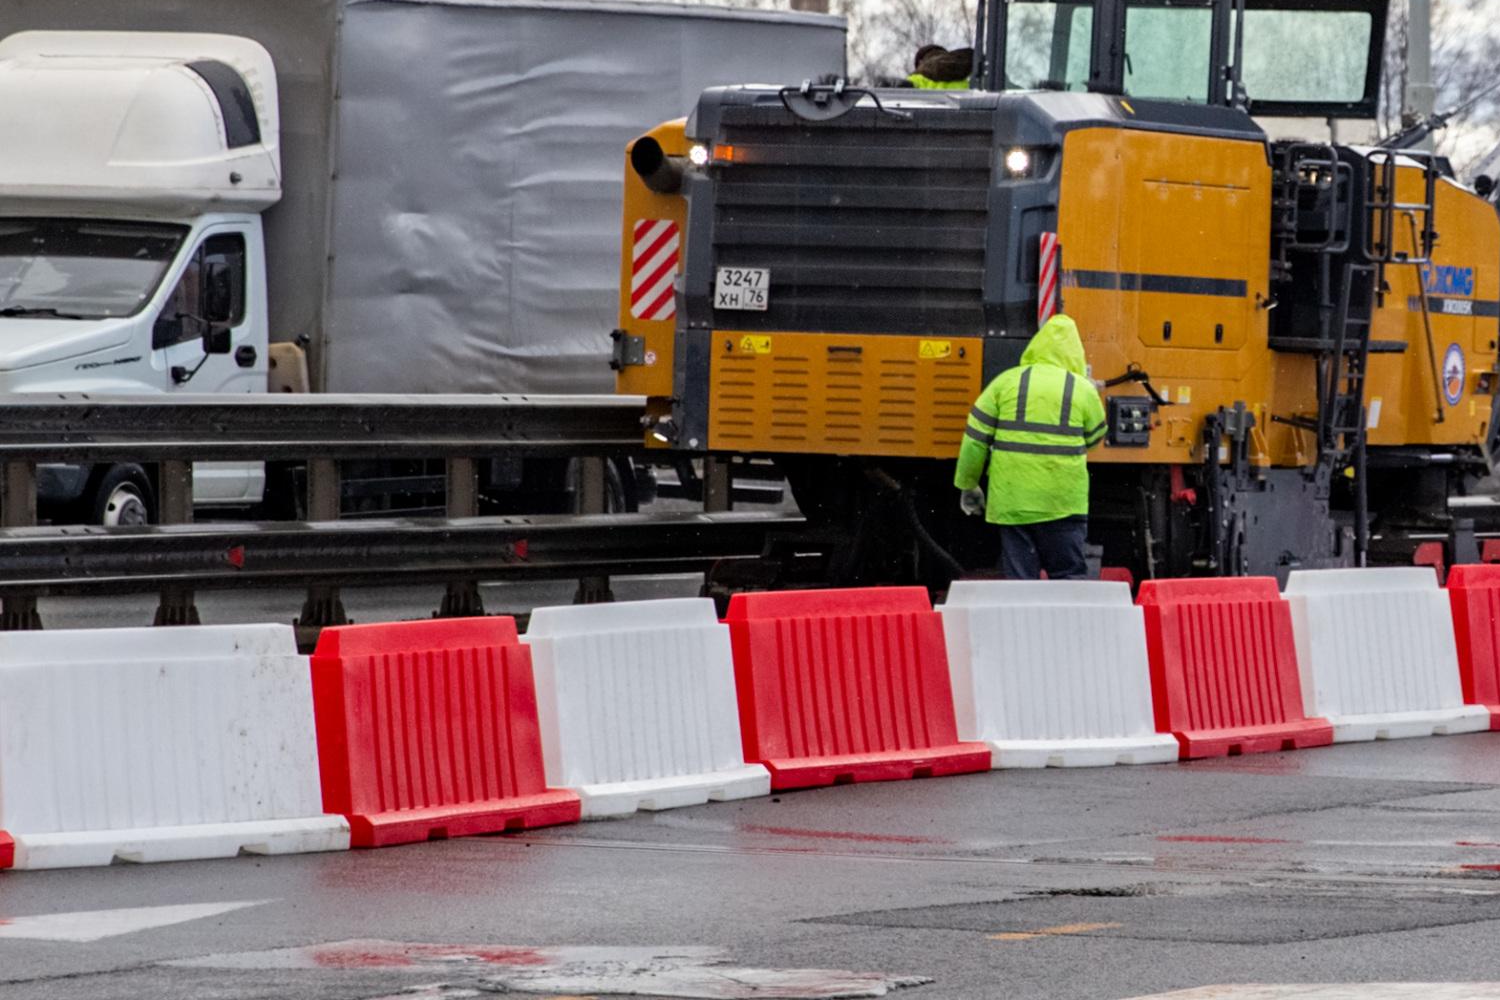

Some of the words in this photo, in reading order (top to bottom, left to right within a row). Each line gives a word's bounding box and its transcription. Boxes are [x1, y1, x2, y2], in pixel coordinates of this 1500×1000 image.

[723, 269, 763, 287] 3247
[719, 292, 740, 306] ХН
[748, 289, 764, 303] 76
